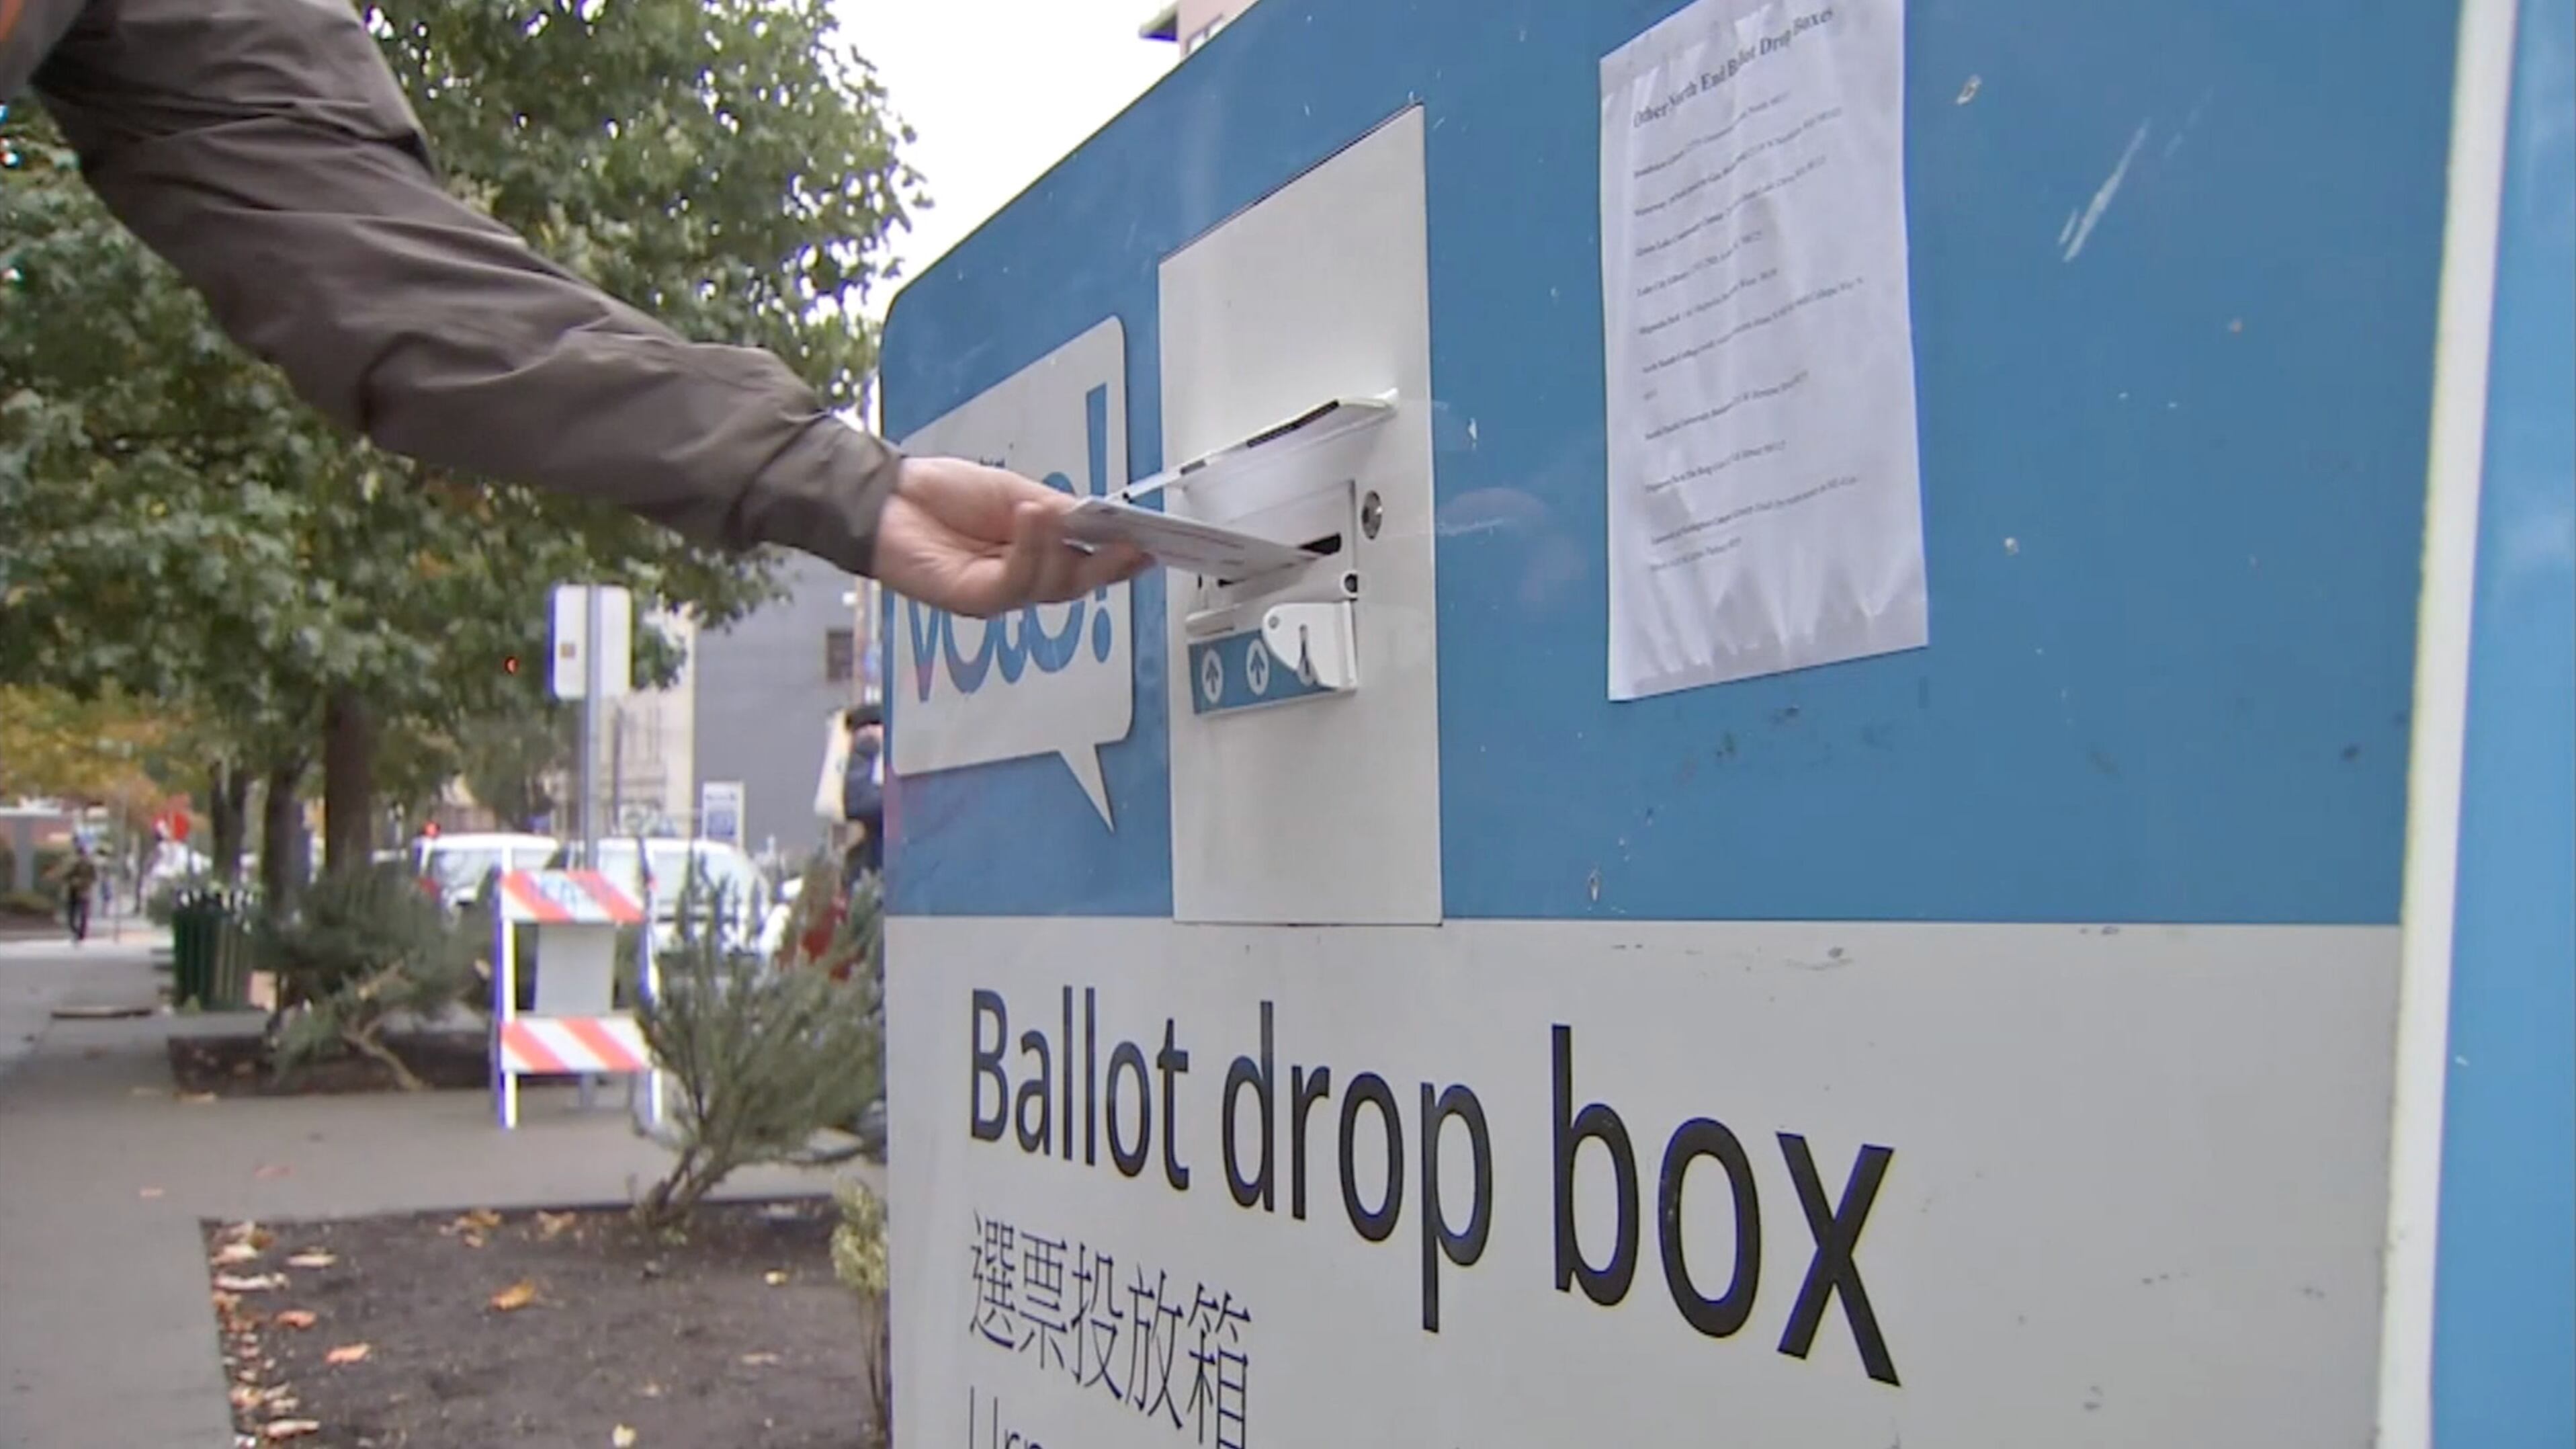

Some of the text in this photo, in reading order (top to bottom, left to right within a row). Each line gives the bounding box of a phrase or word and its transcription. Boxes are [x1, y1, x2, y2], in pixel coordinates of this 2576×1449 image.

[1633, 103, 1668, 128] Other
[1701, 65, 1725, 91] End
[1760, 30, 1791, 56] Drop
[970, 985, 1901, 1387] Ballot drop box
[970, 1208, 1252, 1448] 選票投放箱
